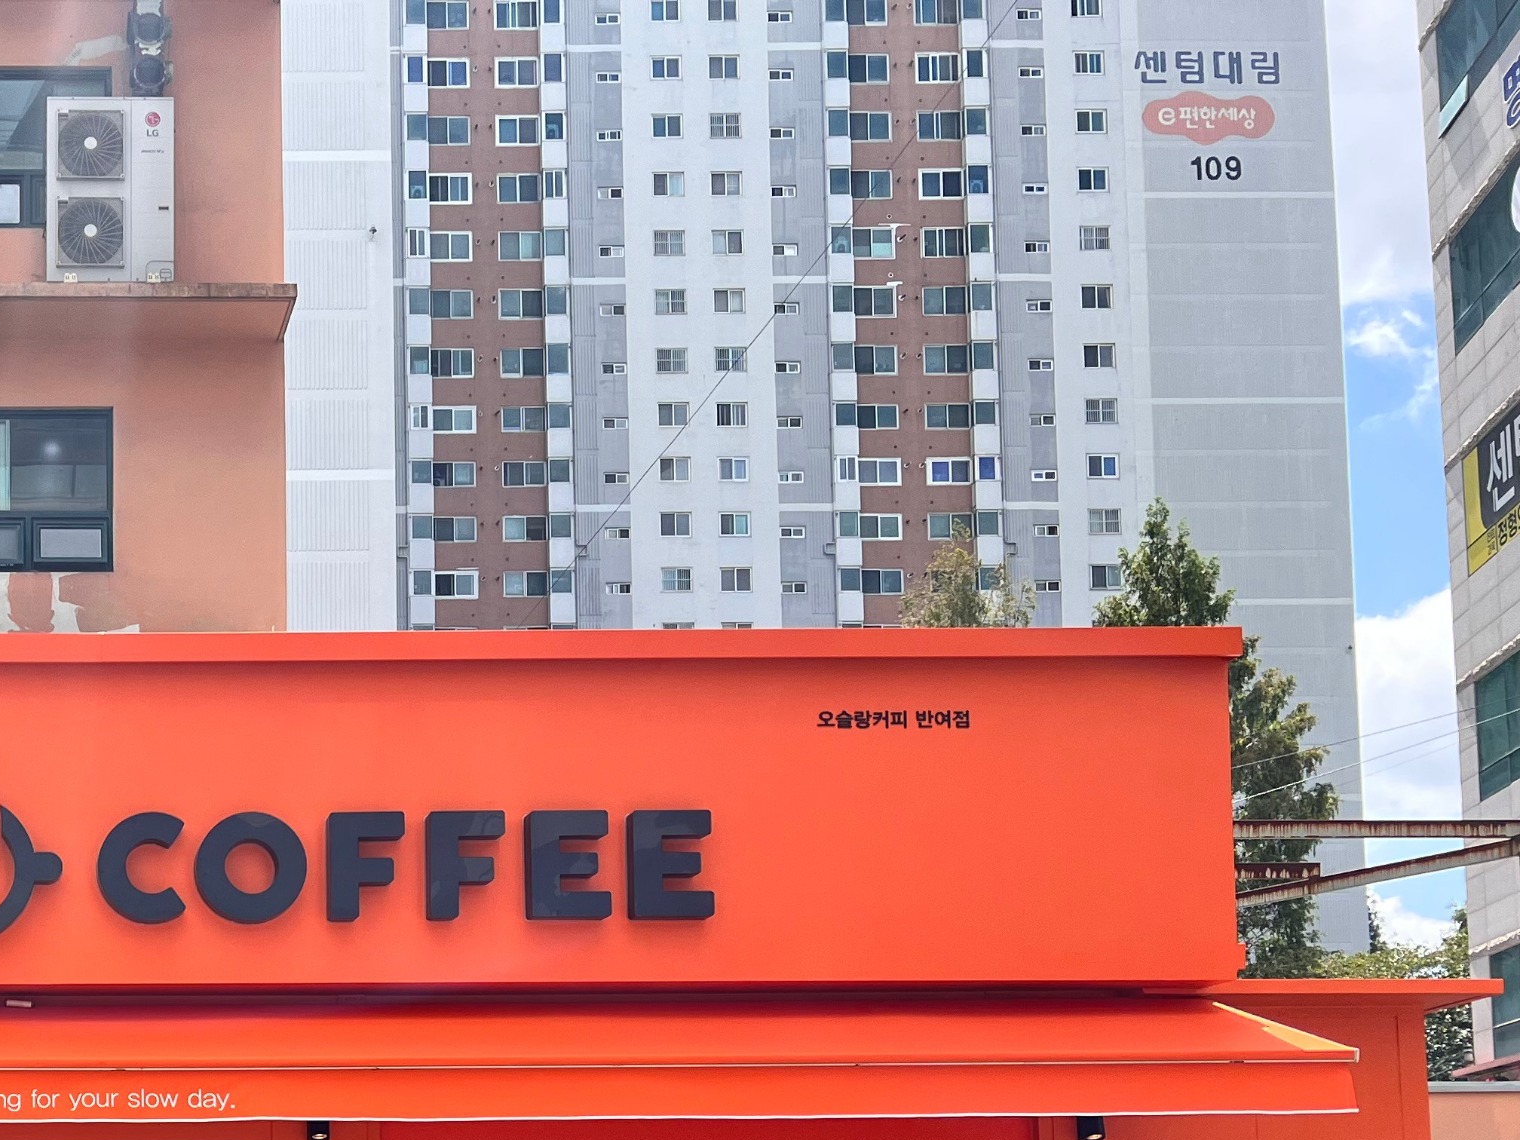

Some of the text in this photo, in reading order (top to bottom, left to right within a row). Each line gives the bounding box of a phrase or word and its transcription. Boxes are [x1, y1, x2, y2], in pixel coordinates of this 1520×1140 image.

[1134, 51, 1280, 84] 센텀대림
[1158, 106, 1256, 129] e편한세상
[146, 129, 159, 137] LG
[1190, 156, 1242, 181] 109
[817, 710, 970, 730] 오슬랑커피 반여점
[96, 809, 715, 924] COFFEE
[31, 1088, 60, 1109] for
[69, 1091, 119, 1111] your
[128, 1088, 178, 1109] slow
[187, 1088, 236, 1112] day.
